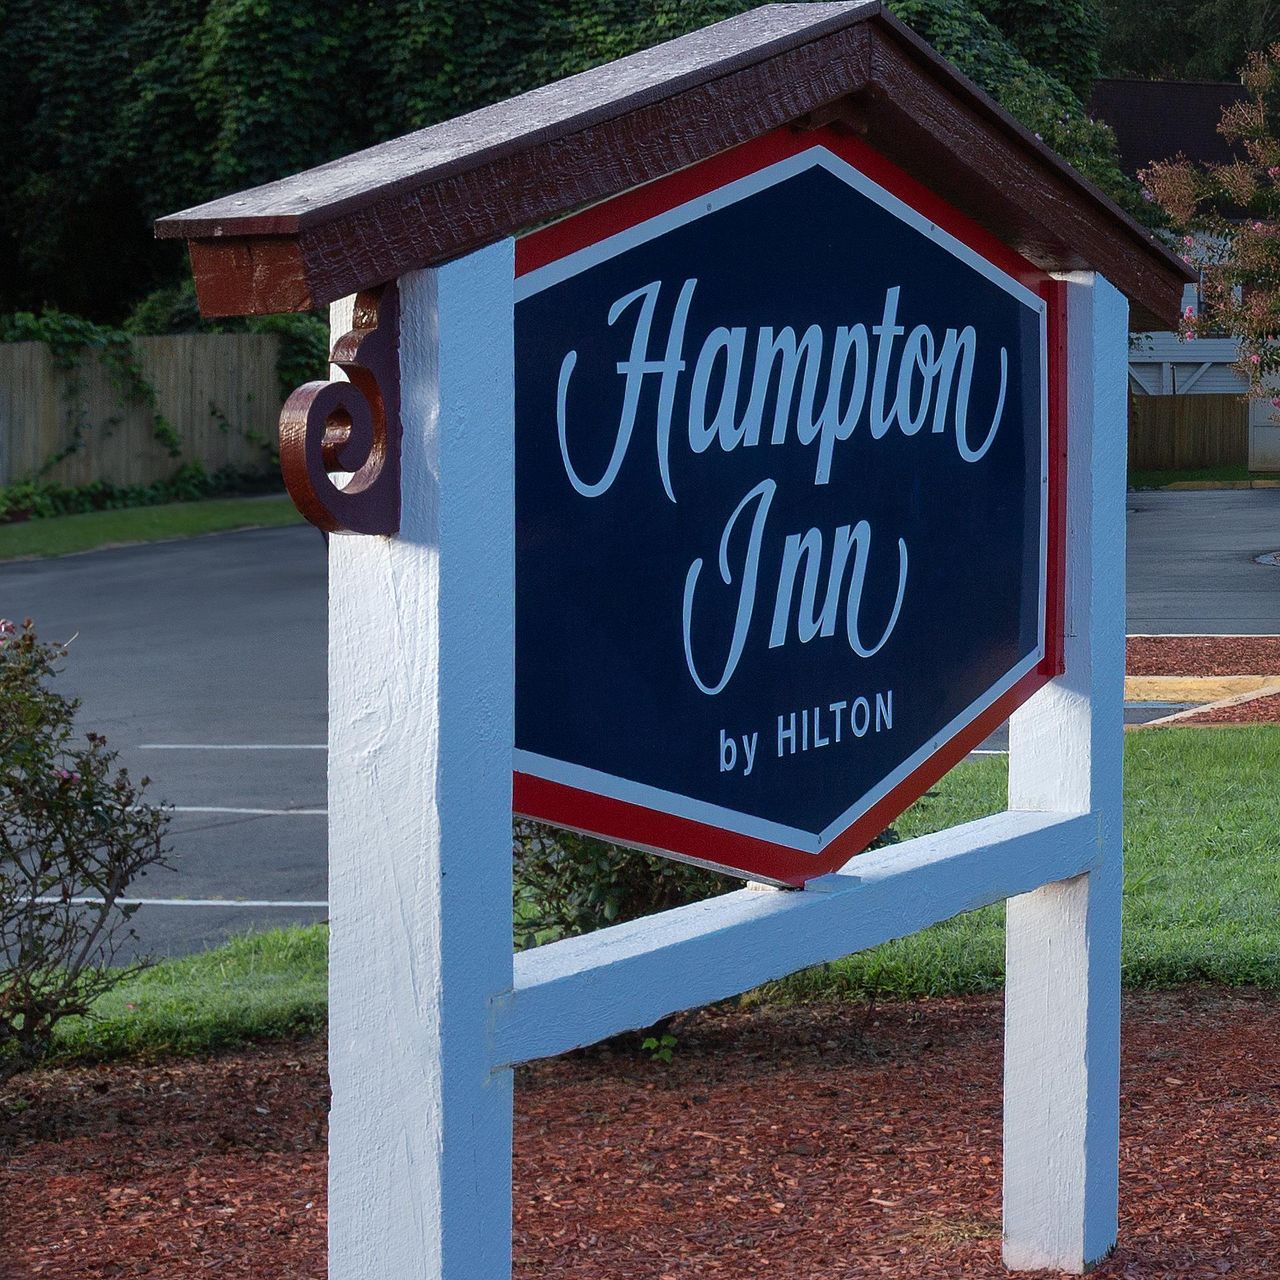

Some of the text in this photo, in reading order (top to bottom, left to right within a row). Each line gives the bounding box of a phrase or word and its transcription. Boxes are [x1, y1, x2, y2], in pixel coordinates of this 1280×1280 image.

[556, 277, 1008, 503] Hampton
[682, 477, 909, 696] Inn
[719, 689, 893, 777] by HILTON
